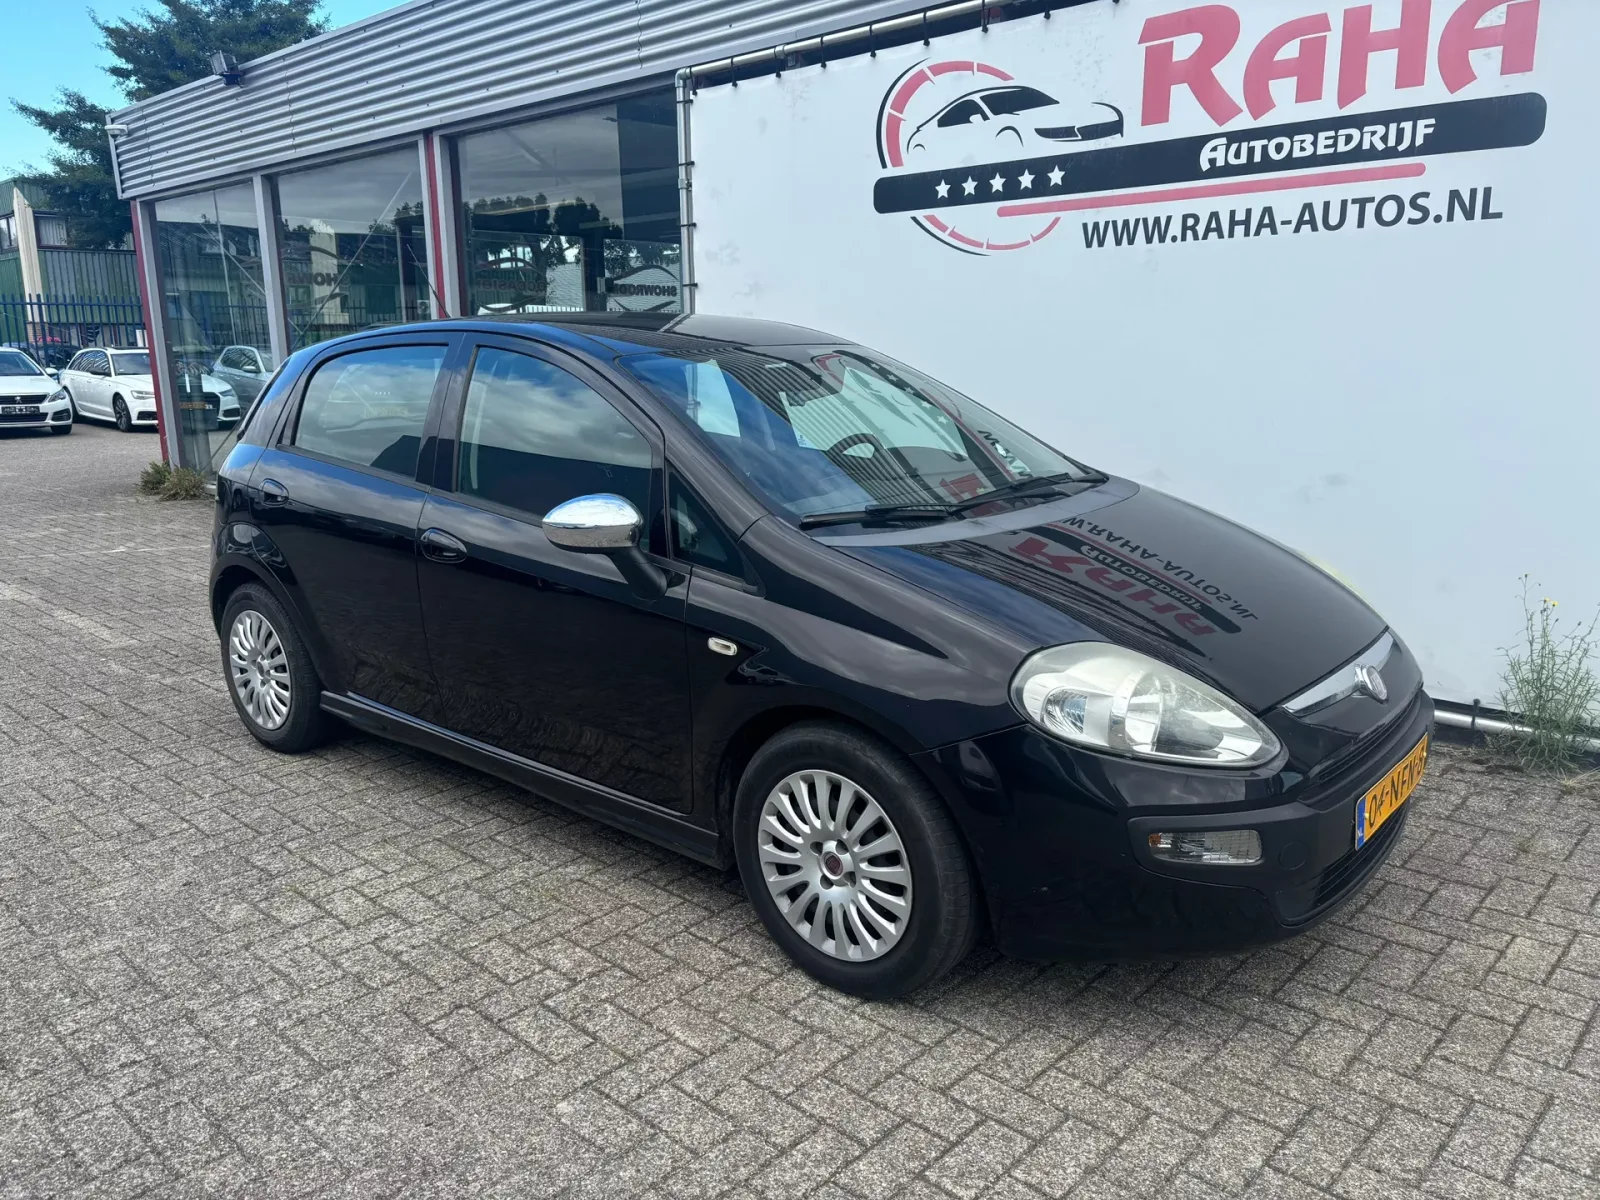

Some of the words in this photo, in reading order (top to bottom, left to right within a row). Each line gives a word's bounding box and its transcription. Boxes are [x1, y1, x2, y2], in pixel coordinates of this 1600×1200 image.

[1138, 0, 1540, 127] RAHA
[1200, 118, 1436, 172] AUTOBEDRIJF
[1081, 186, 1503, 248] WWW.RAHA-AUTOS.NL
